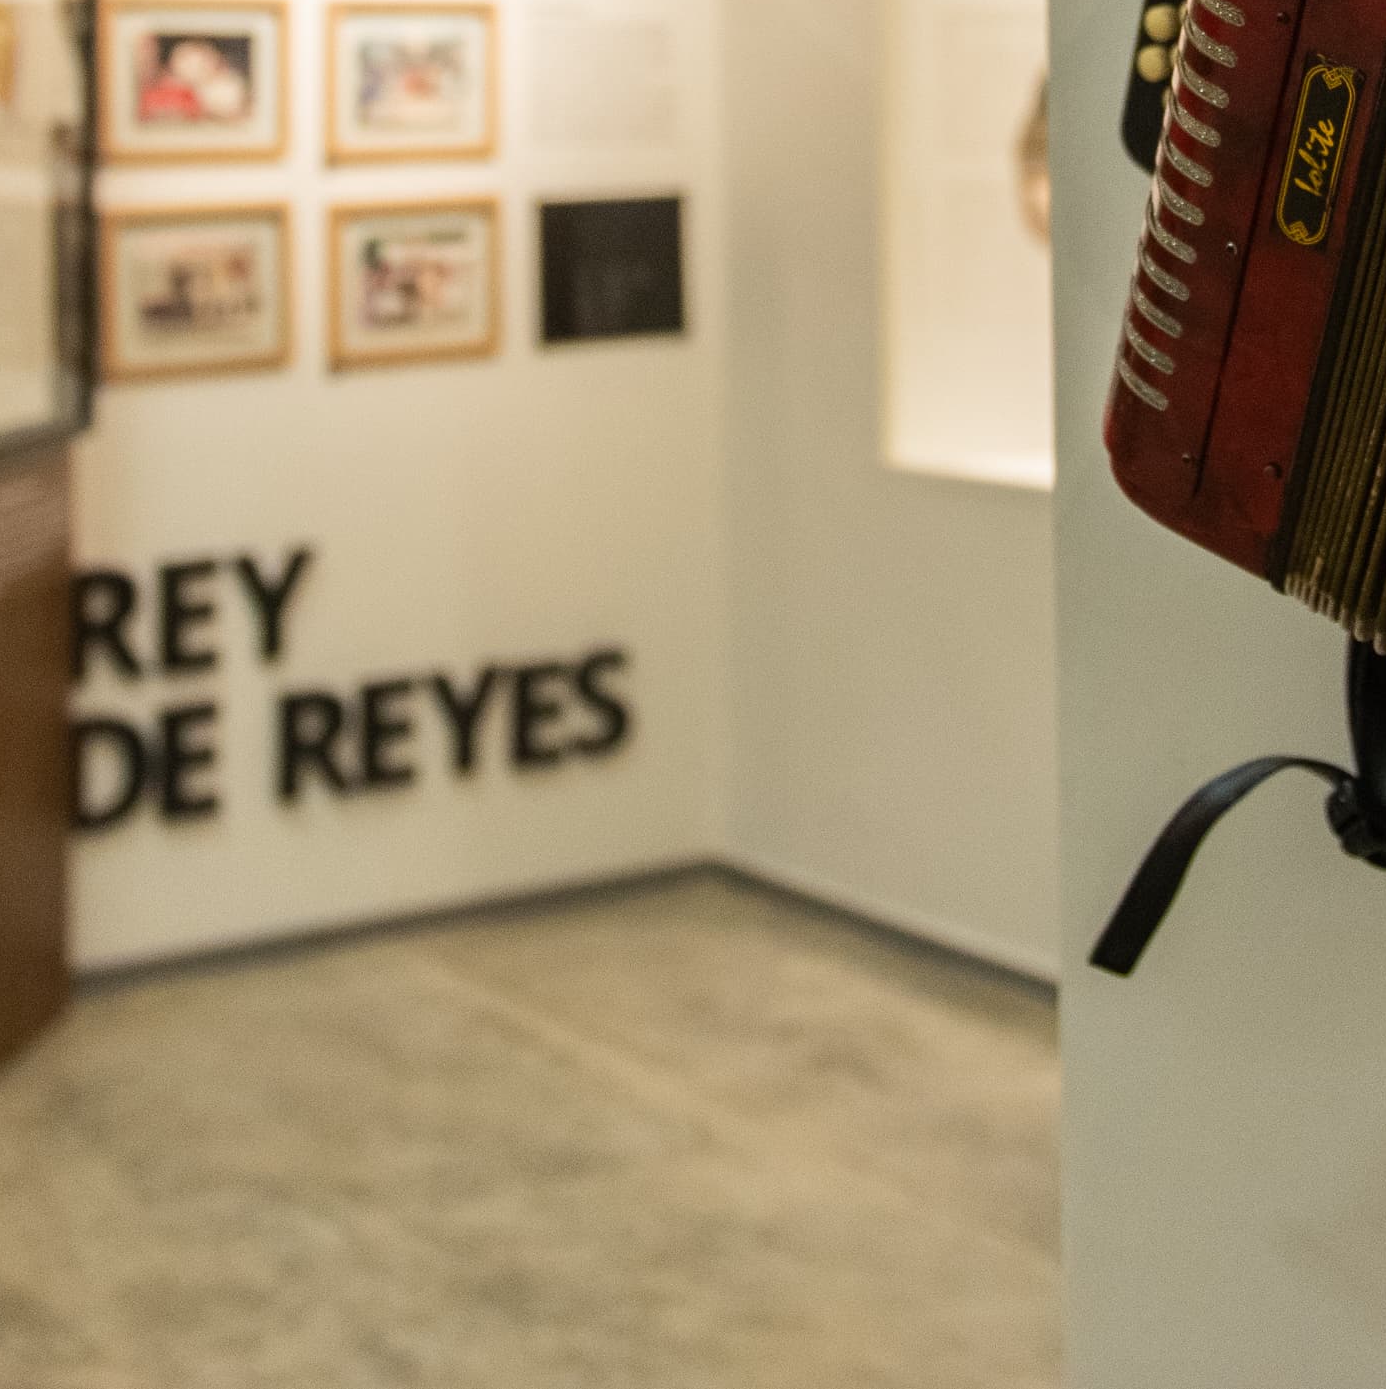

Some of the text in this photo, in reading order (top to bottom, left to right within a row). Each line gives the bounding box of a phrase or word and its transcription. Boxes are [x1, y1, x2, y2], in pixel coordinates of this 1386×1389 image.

[70, 543, 313, 682] REY
[69, 646, 631, 832] DE REYES
